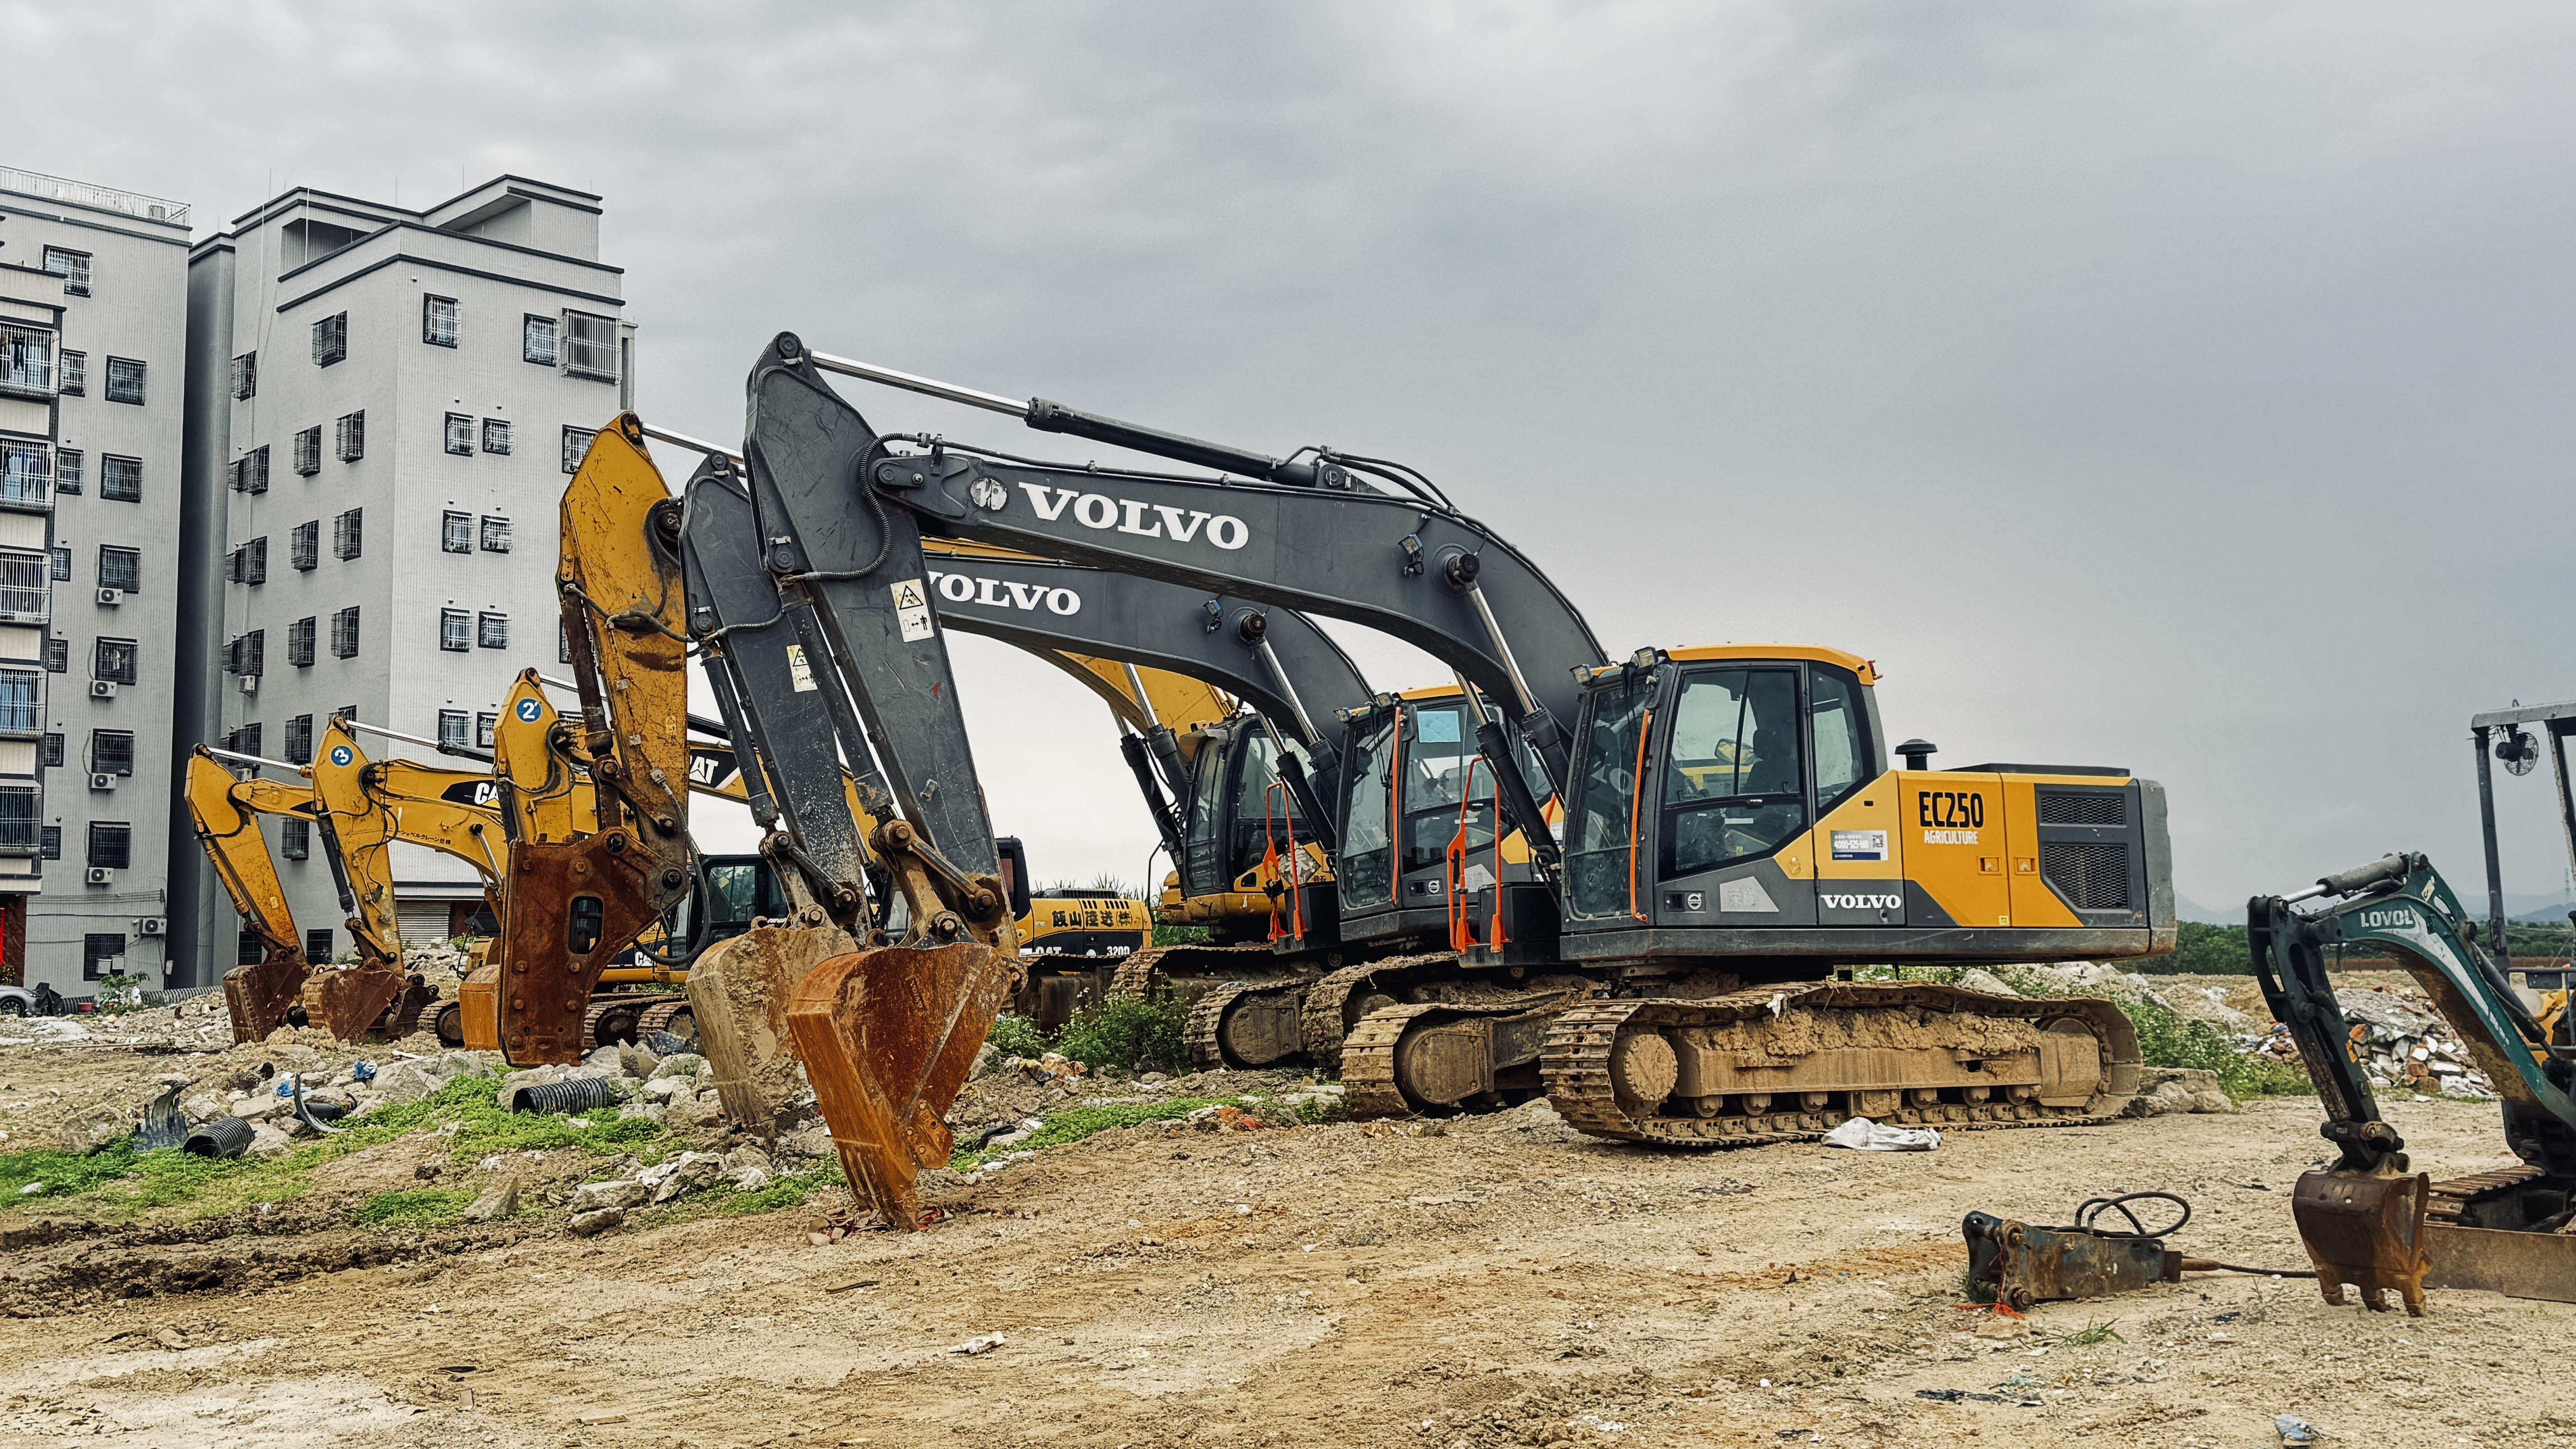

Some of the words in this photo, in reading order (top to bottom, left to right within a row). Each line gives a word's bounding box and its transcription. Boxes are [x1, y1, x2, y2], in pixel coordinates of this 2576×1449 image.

[1018, 482, 1249, 550] VOLVO
[334, 749, 349, 763] 3
[689, 754, 719, 784] AT
[474, 782, 499, 805] CA
[1918, 791, 1984, 828] EC250
[1924, 830, 1979, 844] AGRICULTURE
[1820, 894, 1902, 909] VOLVO
[2360, 910, 2413, 928] LOVOL
[635, 951, 657, 967] CA
